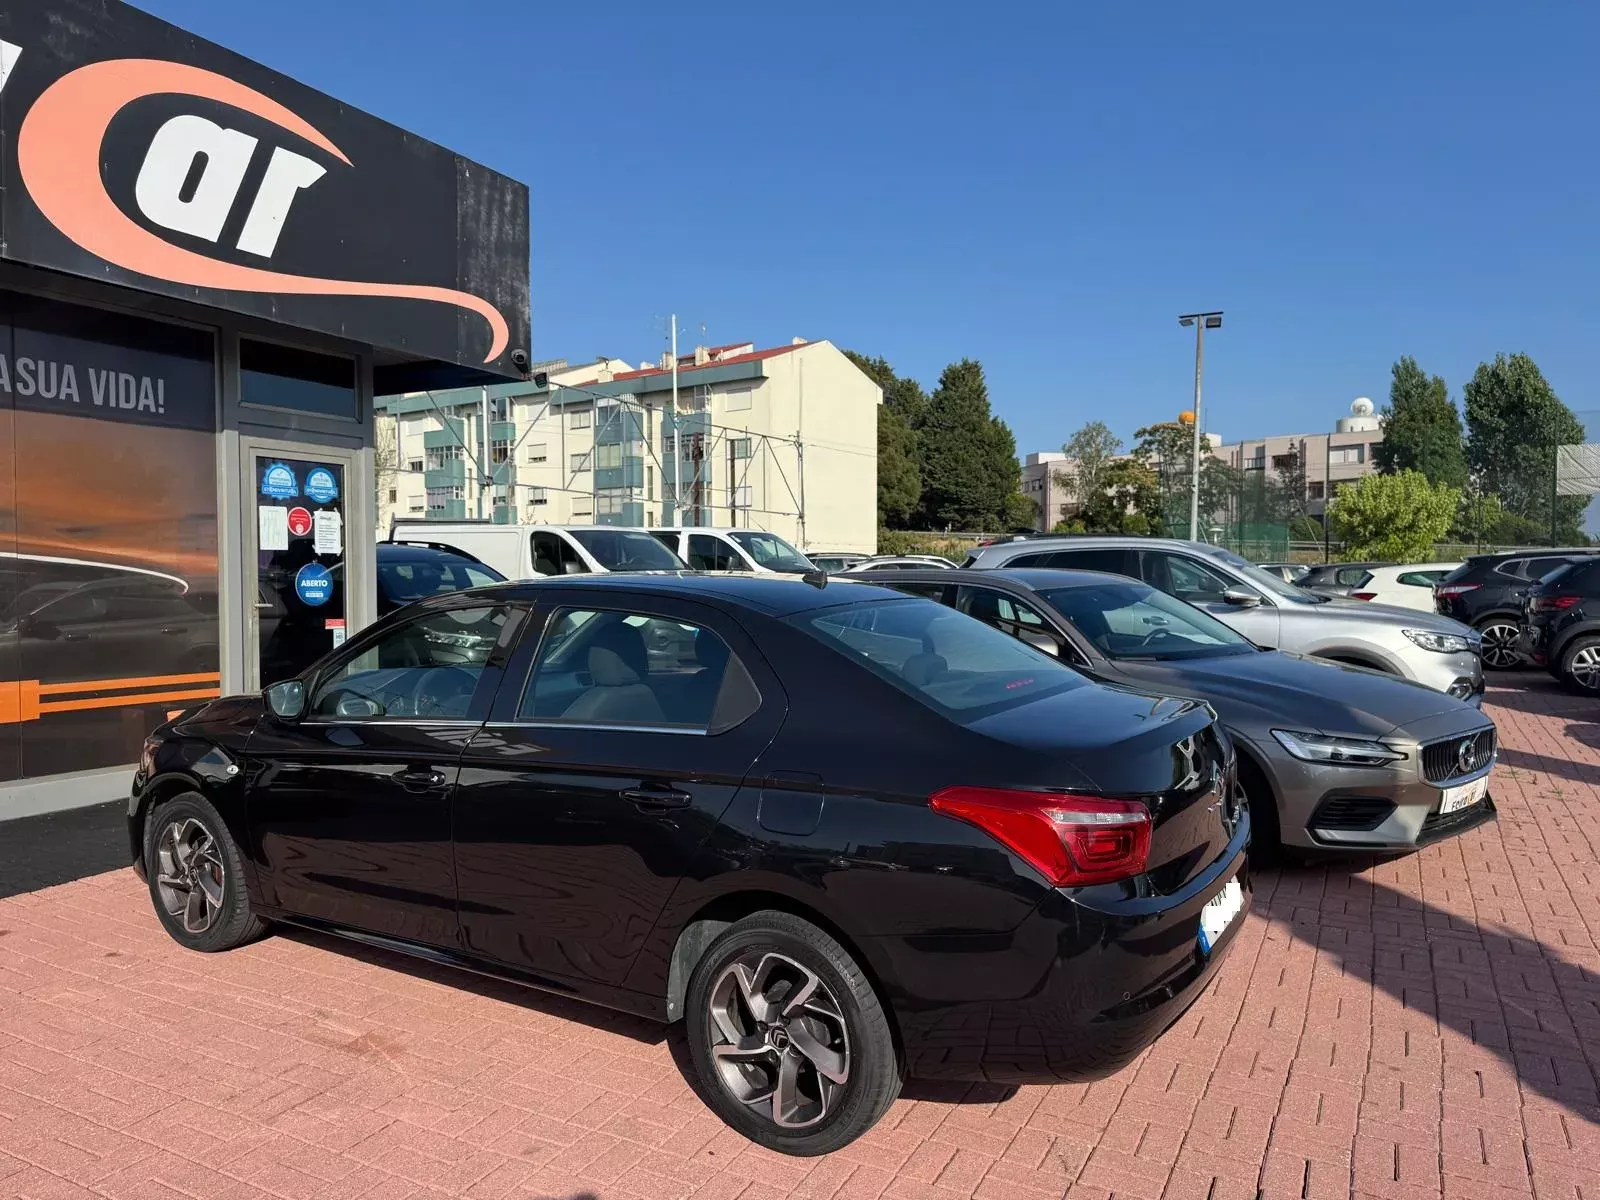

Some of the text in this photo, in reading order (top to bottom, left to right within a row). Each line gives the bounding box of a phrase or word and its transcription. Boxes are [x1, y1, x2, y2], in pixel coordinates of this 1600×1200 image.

[16, 357, 80, 403] SUA
[88, 368, 165, 414] VIDA!
[301, 579, 328, 588] ABERTO
